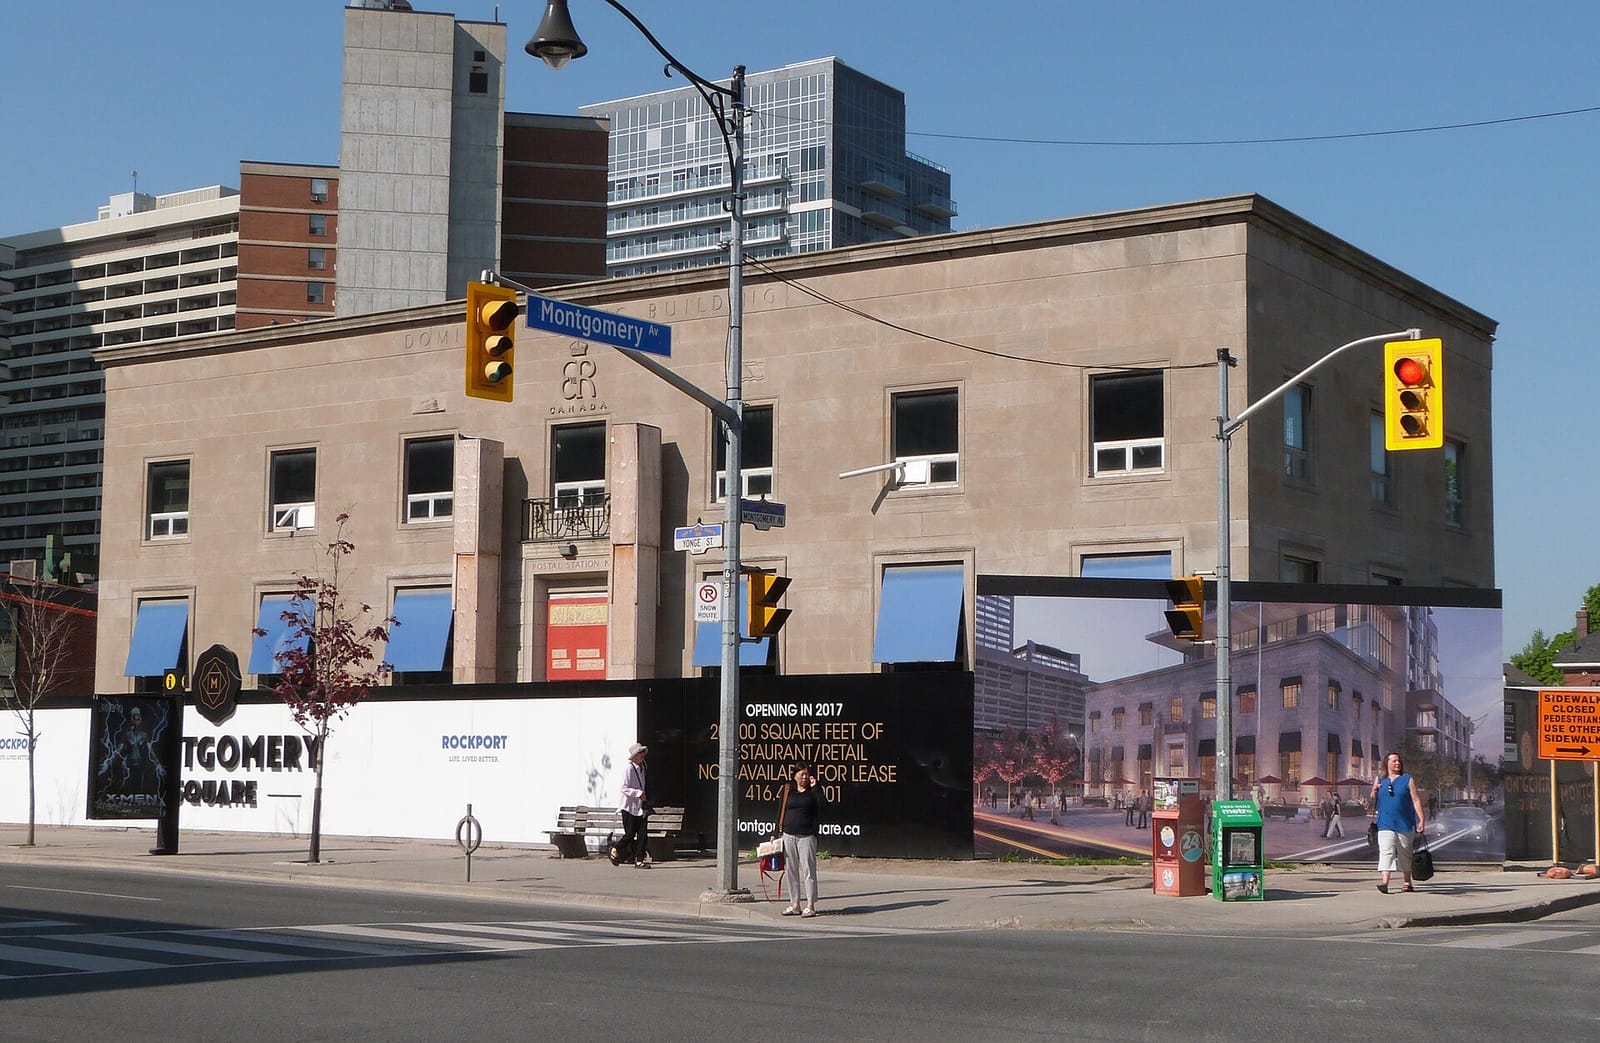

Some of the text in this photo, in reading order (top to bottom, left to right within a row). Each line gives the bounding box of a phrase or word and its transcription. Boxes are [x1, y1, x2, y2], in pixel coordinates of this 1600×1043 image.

[648, 288, 776, 318] BUILDNG
[541, 300, 659, 347] Montgomery Av
[549, 402, 607, 415] CANADA
[682, 537, 713, 549] YONGE ST
[532, 562, 562, 571] POSTAL
[566, 560, 600, 569] STATION
[210, 677, 218, 689] M
[745, 702, 843, 717] OPENING IN 2017
[1552, 705, 1596, 714] CLOSED
[1543, 714, 1600, 724] PEDESTRIAN
[760, 723, 820, 740] SQUARE
[825, 723, 857, 740] FEET
[861, 722, 884, 740] OF
[1544, 724, 1565, 733] USE
[442, 735, 508, 750] ROCKPORT
[738, 743, 869, 763] STAURANT/RETAIL
[698, 763, 897, 783] NO AVAILA FOR LEASE
[1182, 833, 1200, 850] 24
